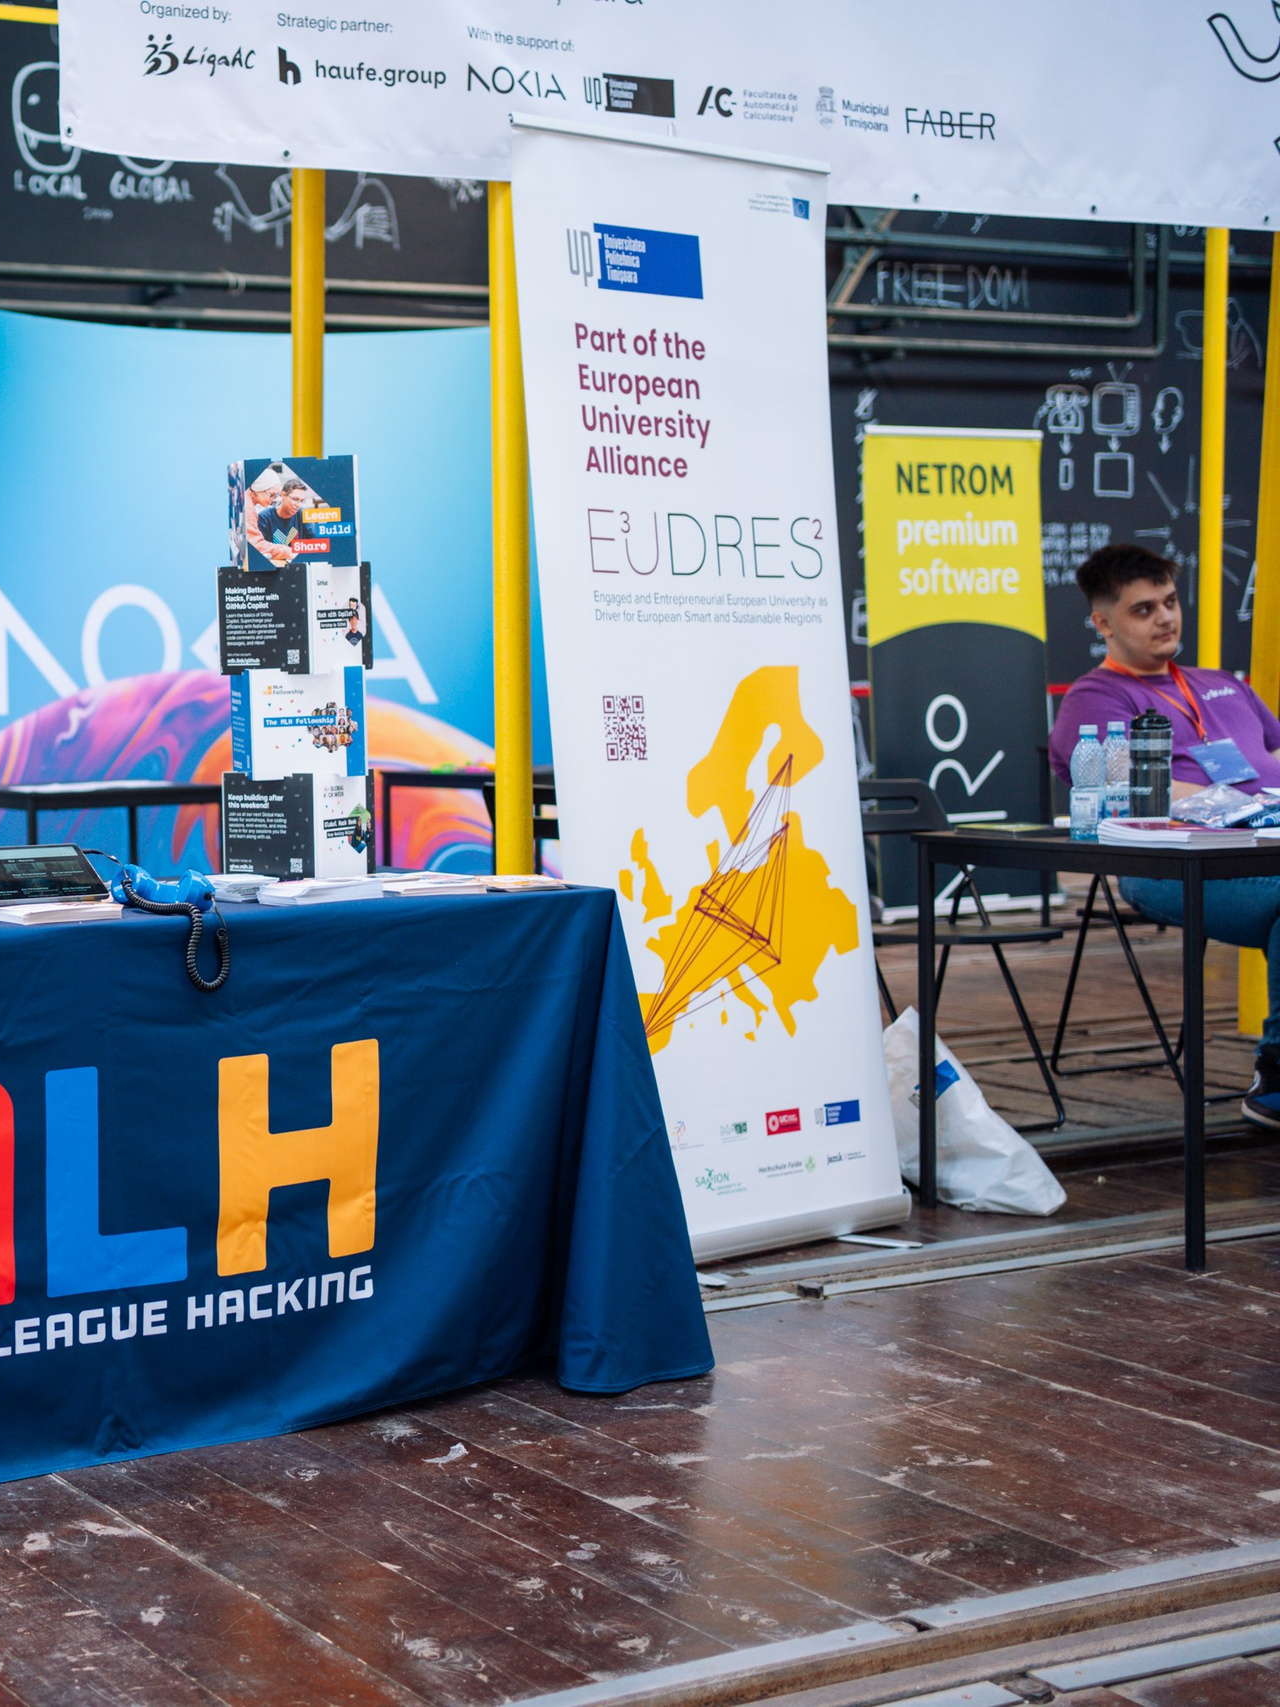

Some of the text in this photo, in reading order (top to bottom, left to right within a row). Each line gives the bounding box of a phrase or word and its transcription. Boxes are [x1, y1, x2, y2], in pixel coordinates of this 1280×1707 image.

[140, 0, 232, 23] Organized by:
[277, 13, 393, 34] Strategic partner:
[467, 26, 575, 52] With the support of:
[183, 46, 256, 76] LigaAC
[315, 60, 447, 89] haufe.group
[467, 63, 567, 101] NOKIA
[842, 99, 889, 117] Municipiul
[905, 107, 996, 141] FABER
[13, 169, 87, 200] LOCAL
[109, 171, 194, 203] GLOBAL
[603, 233, 646, 253] Universitatea
[605, 249, 640, 268] Politehnica
[876, 260, 1030, 310] FREEDOM
[575, 322, 706, 361] Part of the
[578, 363, 701, 405] European
[581, 404, 711, 449] University
[586, 445, 689, 478] Alliance
[895, 462, 1014, 495] NETROM
[305, 511, 338, 521] Learn
[319, 525, 351, 535] Build
[896, 511, 1019, 556] premium
[293, 541, 327, 552] Share
[898, 558, 1020, 596] software
[225, 587, 247, 596] Making
[246, 594, 265, 602] Faster
[593, 590, 829, 609] Engaged and Entrepreneurial European University as
[225, 602, 269, 610] GitHub Copilot
[595, 608, 823, 627] Driver for European Smart and Sustainable Regions
[280, 718, 293, 726] MLH
[295, 717, 334, 726] Fellowship
[227, 794, 243, 802] Keep
[244, 793, 268, 802] building
[187, 1264, 375, 1332] HACKING
